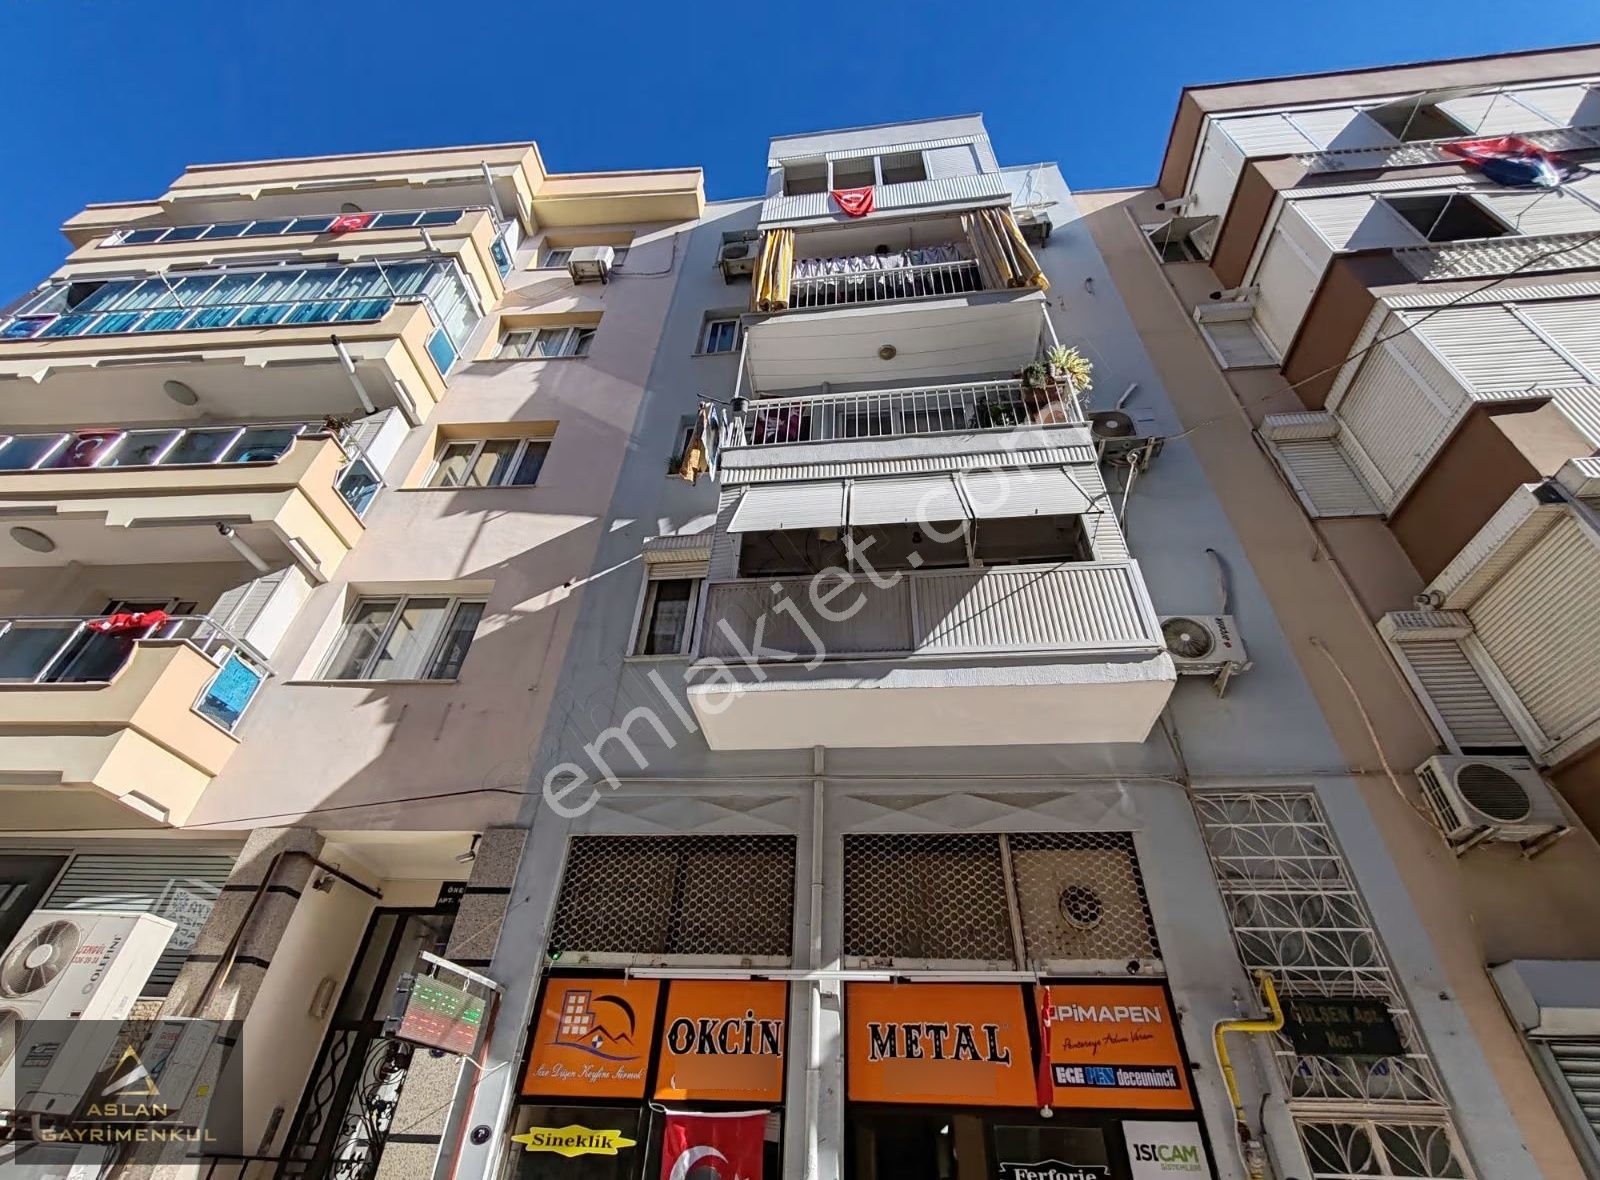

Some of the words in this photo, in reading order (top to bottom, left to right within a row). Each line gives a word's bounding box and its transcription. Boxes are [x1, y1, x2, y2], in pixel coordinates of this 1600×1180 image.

[667, 1008, 784, 1058] OKCİN
[867, 1021, 1012, 1067] METAL
[1116, 1068, 1177, 1087] deceuninck
[531, 1133, 613, 1149] Sineklik
